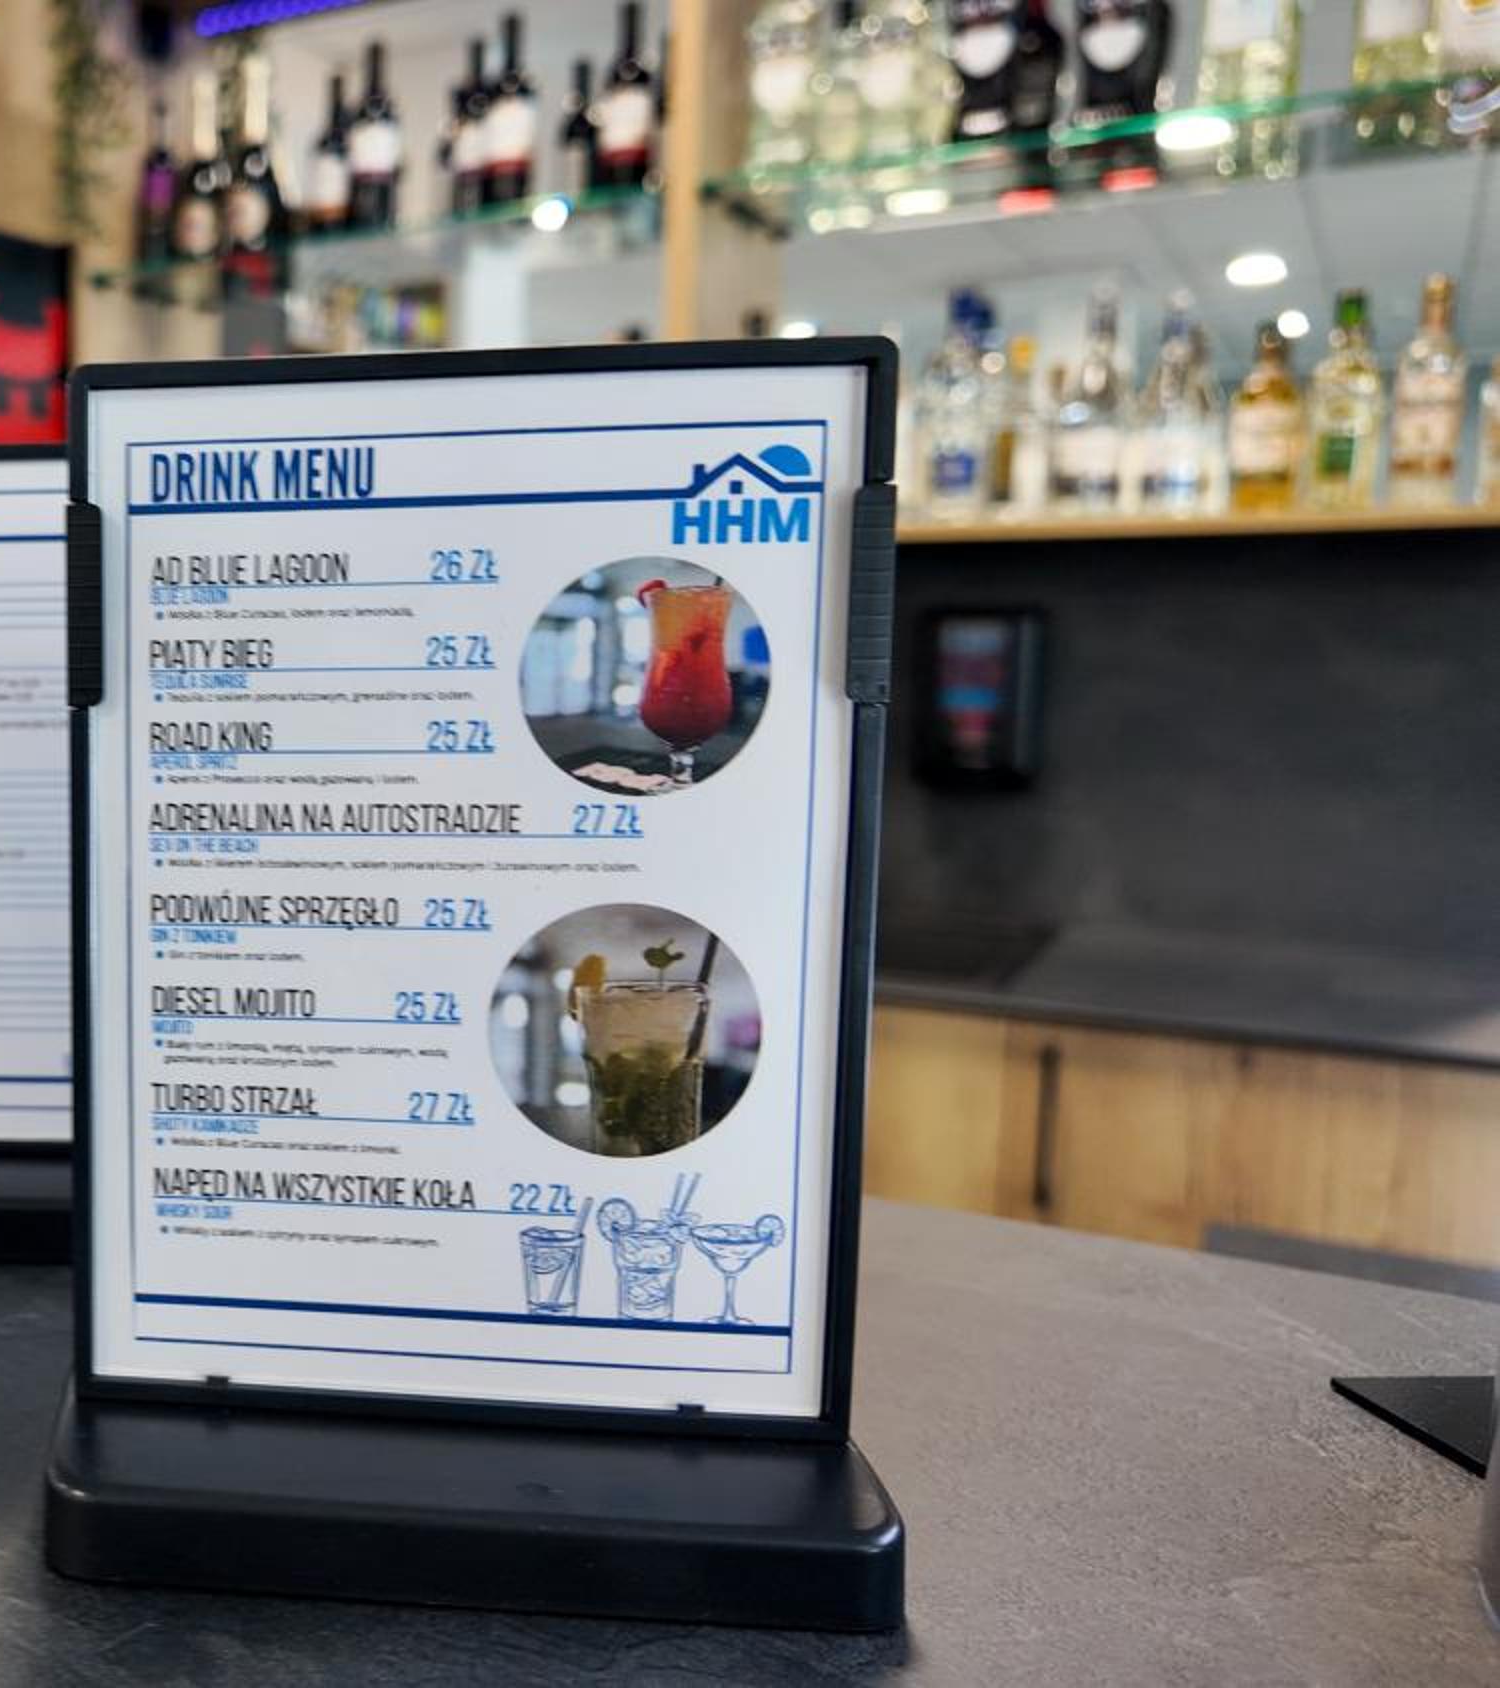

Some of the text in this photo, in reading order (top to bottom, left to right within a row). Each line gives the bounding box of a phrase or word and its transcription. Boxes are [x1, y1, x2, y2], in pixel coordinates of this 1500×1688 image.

[152, 447, 374, 502] DRINK MENU
[672, 498, 810, 544] HHM
[152, 548, 498, 585] AD BLUE LAGOON 26 ZŁ
[150, 635, 495, 674] PIĄTY BIEG 25 ZŁ
[150, 720, 495, 752] ROAD KING 25 ZŁ
[151, 803, 643, 834] ADRENALINA NA AUTOSTRADZIE 27 ZŁ
[151, 889, 491, 930] PODWÓJNE SPRZĘGŁO 25 ZŁ
[152, 985, 461, 1021] DIESEL MOJITO 25 ZŁ
[150, 1082, 475, 1122] TURBO STRZAŁ 27 ZŁ
[153, 1166, 576, 1214] NAPĘD NA WSZYSTKIE KOŁA 22 ZŁ
